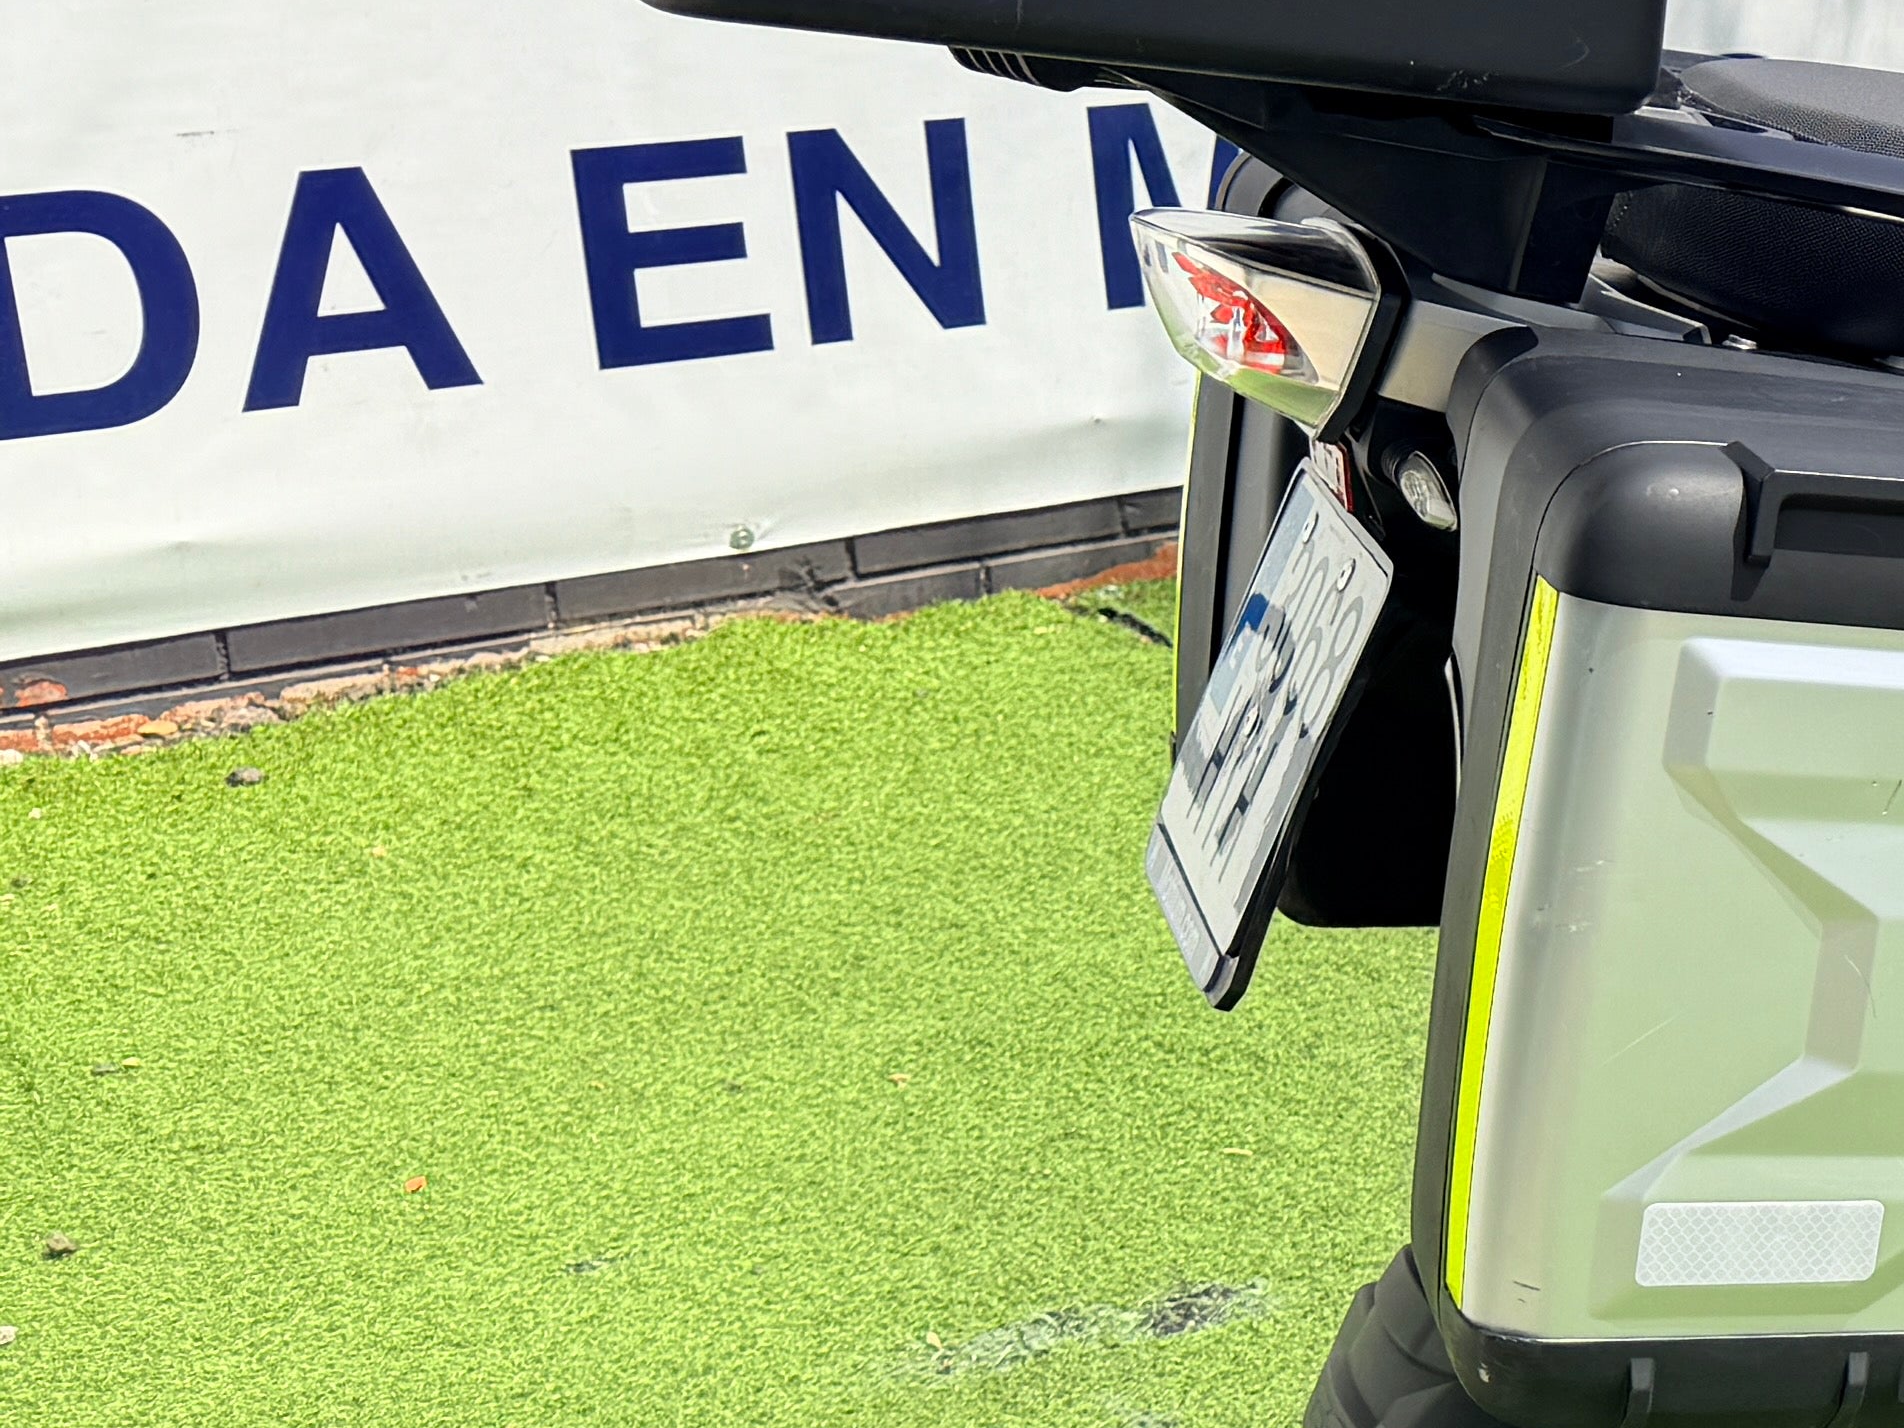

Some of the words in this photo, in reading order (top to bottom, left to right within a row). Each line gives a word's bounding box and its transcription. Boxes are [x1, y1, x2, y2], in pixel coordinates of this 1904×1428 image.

[0, 166, 483, 440] DA
[571, 117, 986, 369] EN
[1087, 103, 1242, 310] M
